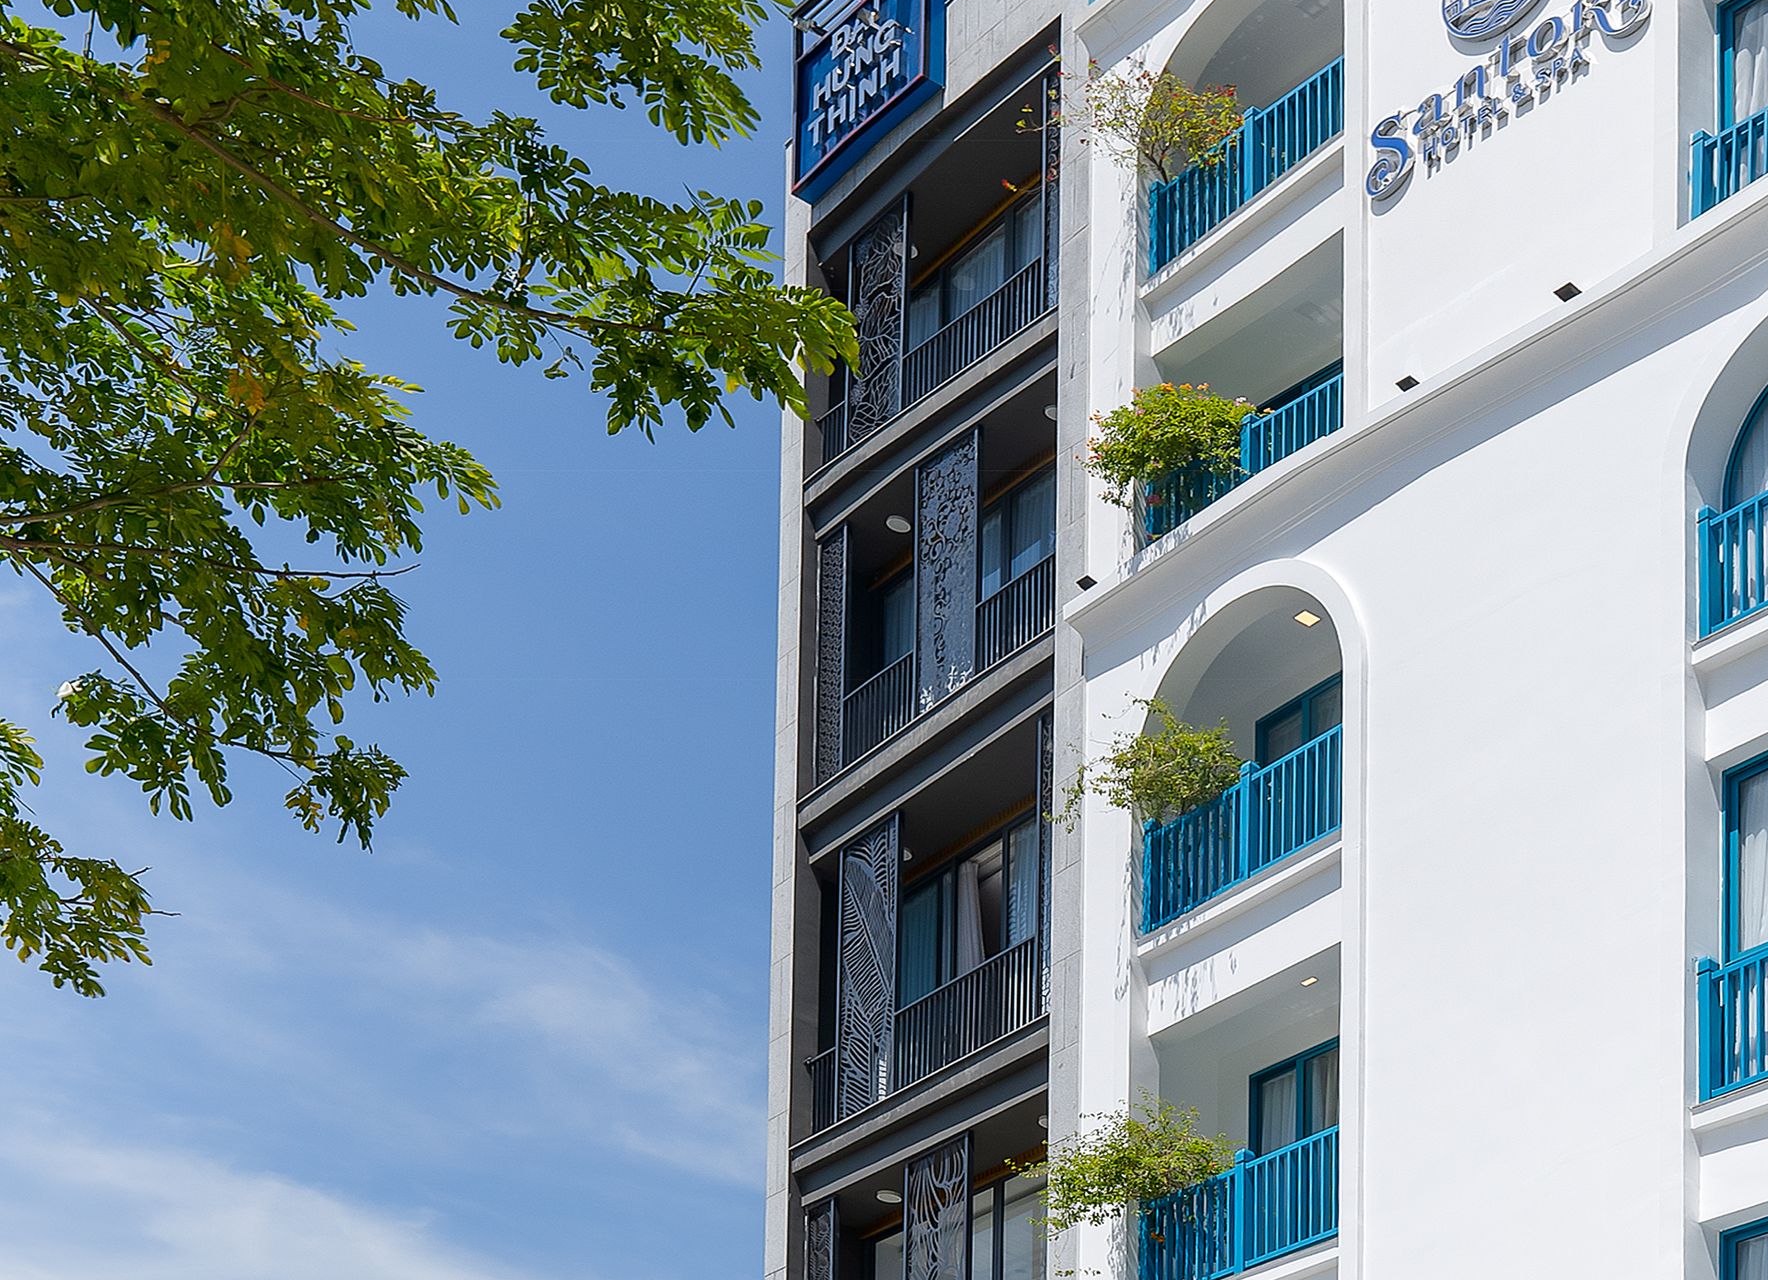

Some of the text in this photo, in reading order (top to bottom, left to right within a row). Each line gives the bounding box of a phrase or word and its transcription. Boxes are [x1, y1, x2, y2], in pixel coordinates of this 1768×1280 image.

[1422, 47, 1585, 162] HOTEL & SPA
